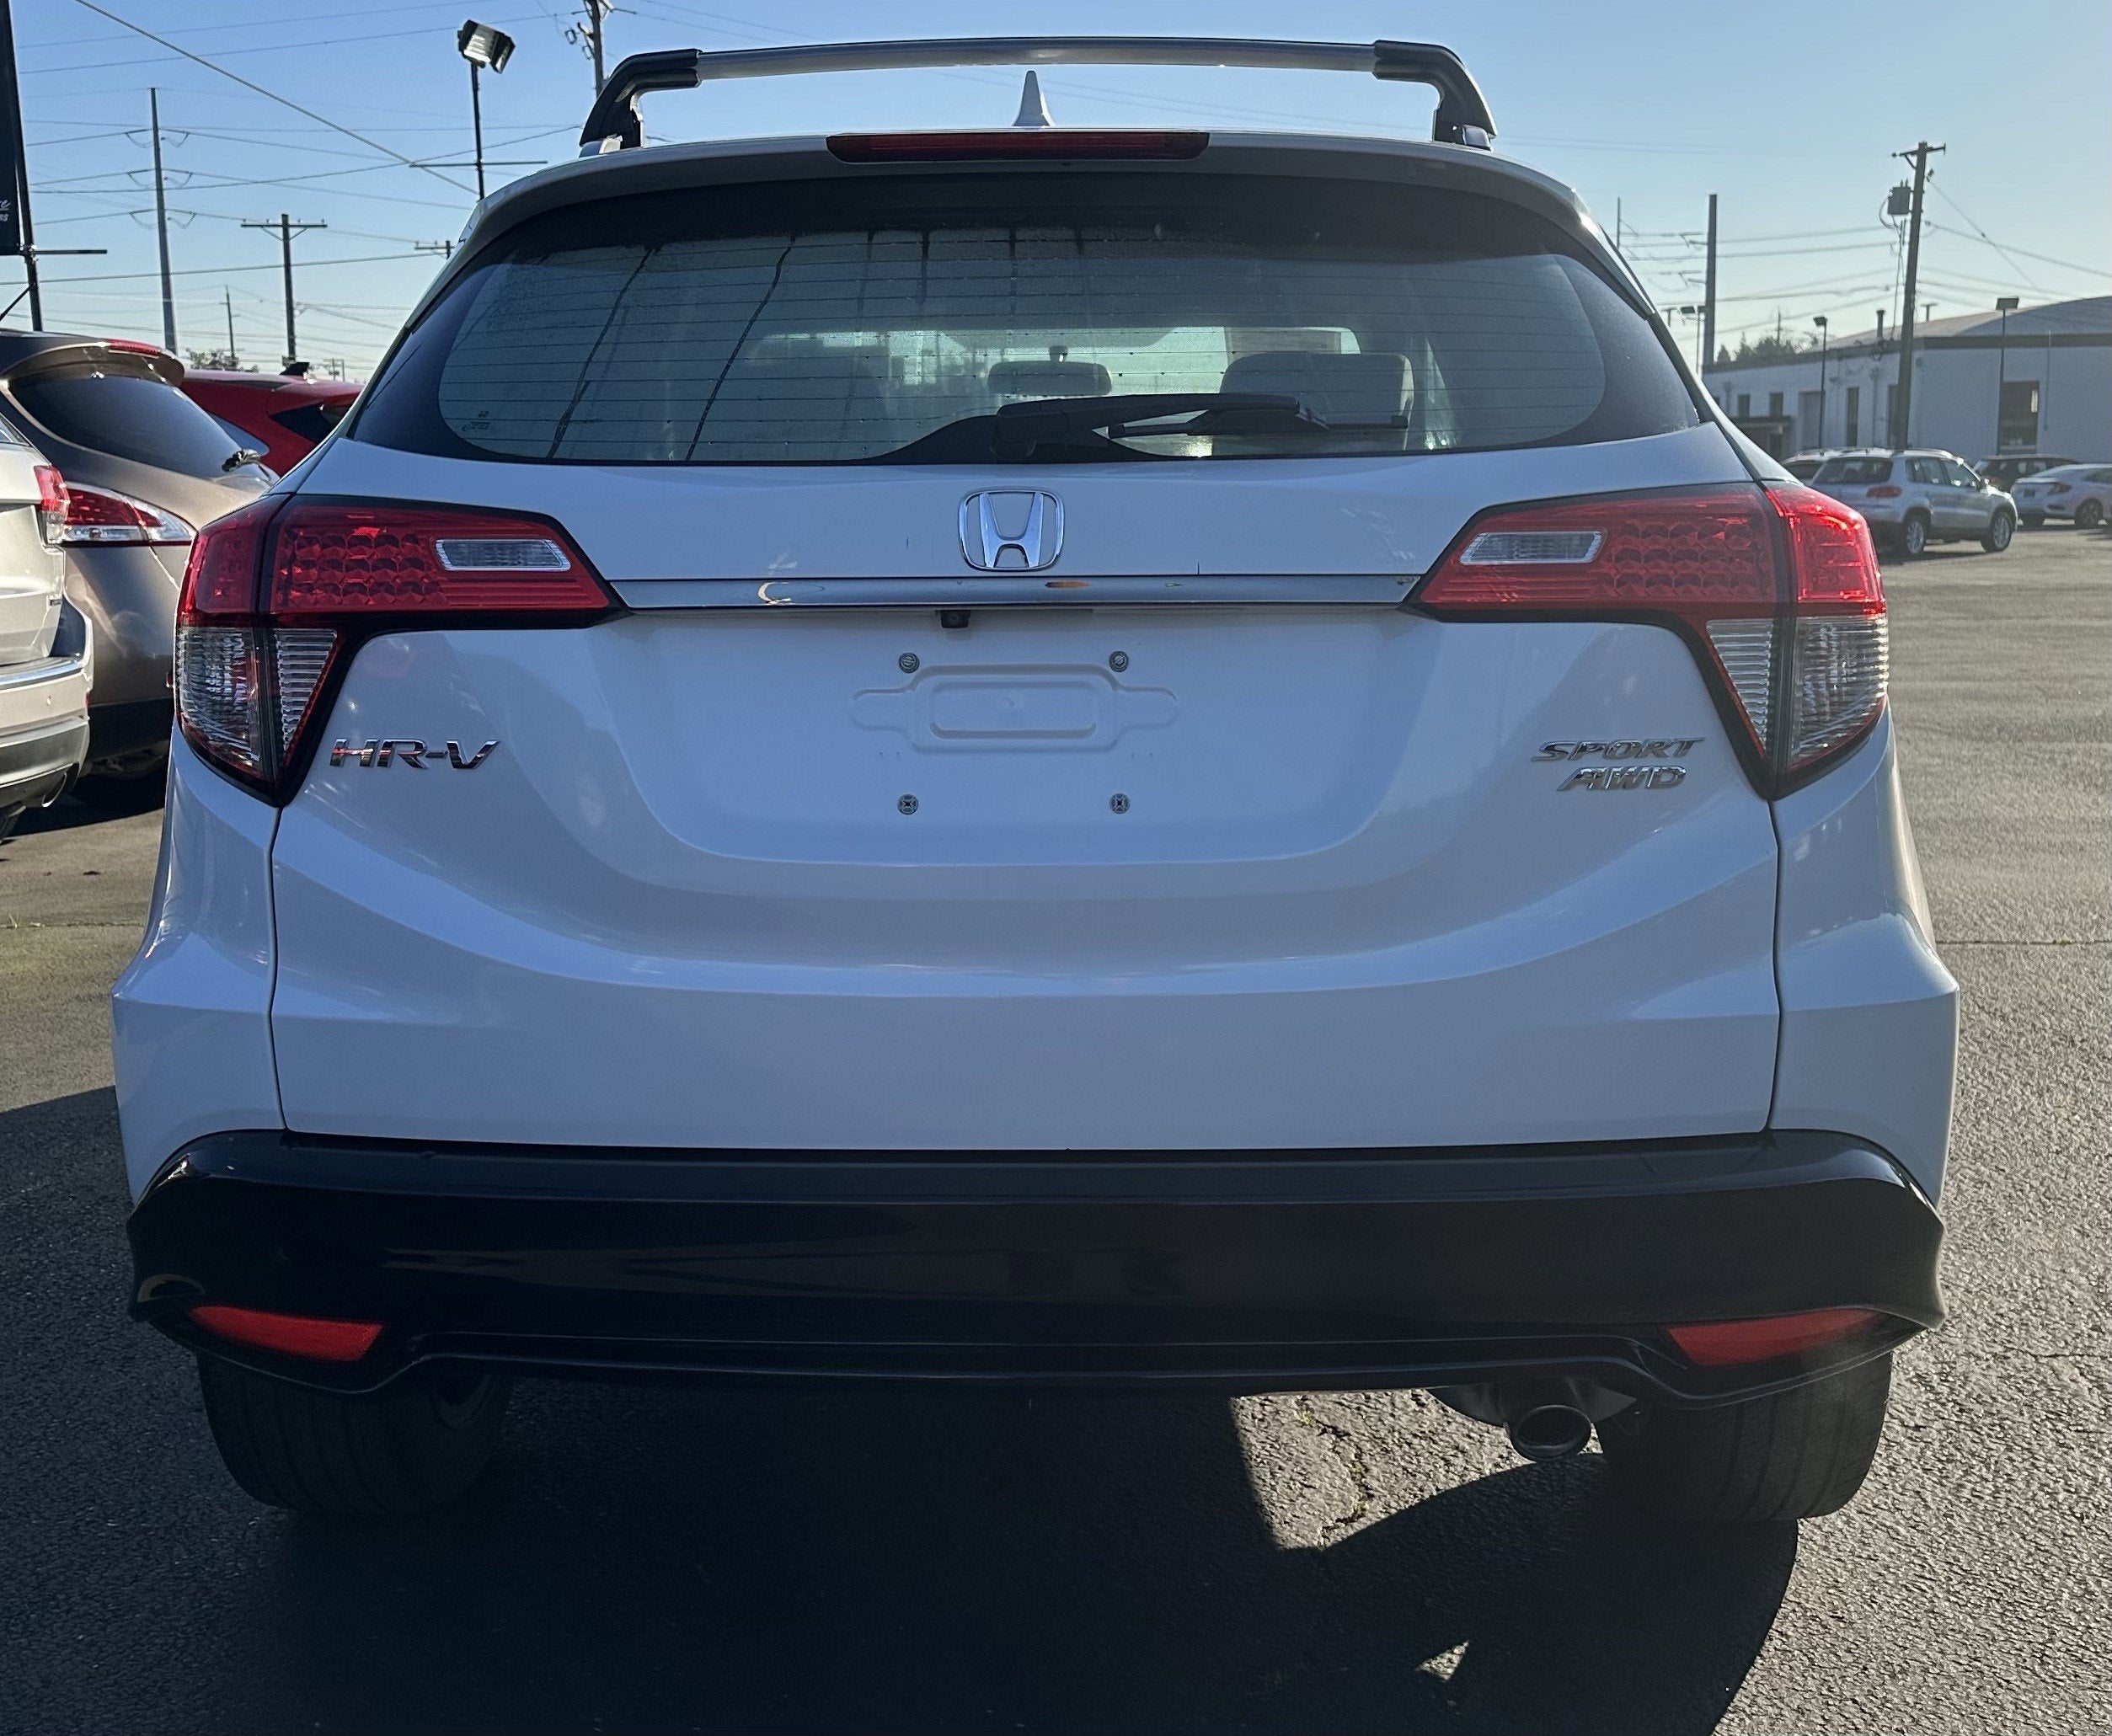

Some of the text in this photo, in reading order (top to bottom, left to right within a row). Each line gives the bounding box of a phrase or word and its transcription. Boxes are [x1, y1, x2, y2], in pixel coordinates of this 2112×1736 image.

[329, 736, 500, 770] HR-V
[1531, 737, 1706, 762] SPORT
[1555, 764, 1687, 791] AWD
